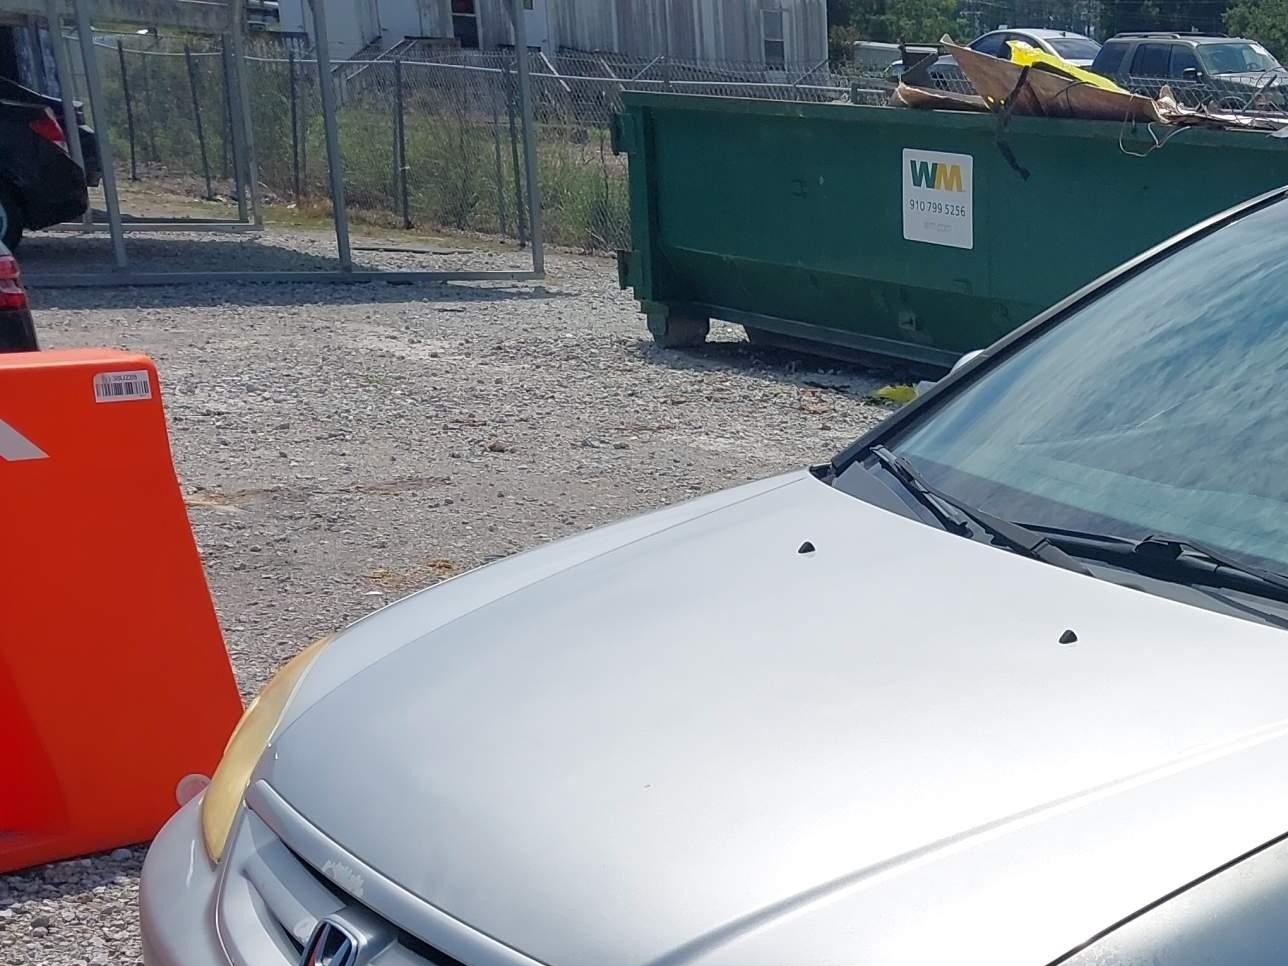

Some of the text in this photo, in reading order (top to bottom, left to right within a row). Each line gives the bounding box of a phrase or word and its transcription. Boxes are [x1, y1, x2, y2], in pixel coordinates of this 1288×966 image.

[910, 160, 963, 193] WM
[909, 199, 966, 217] 910 799 5256
